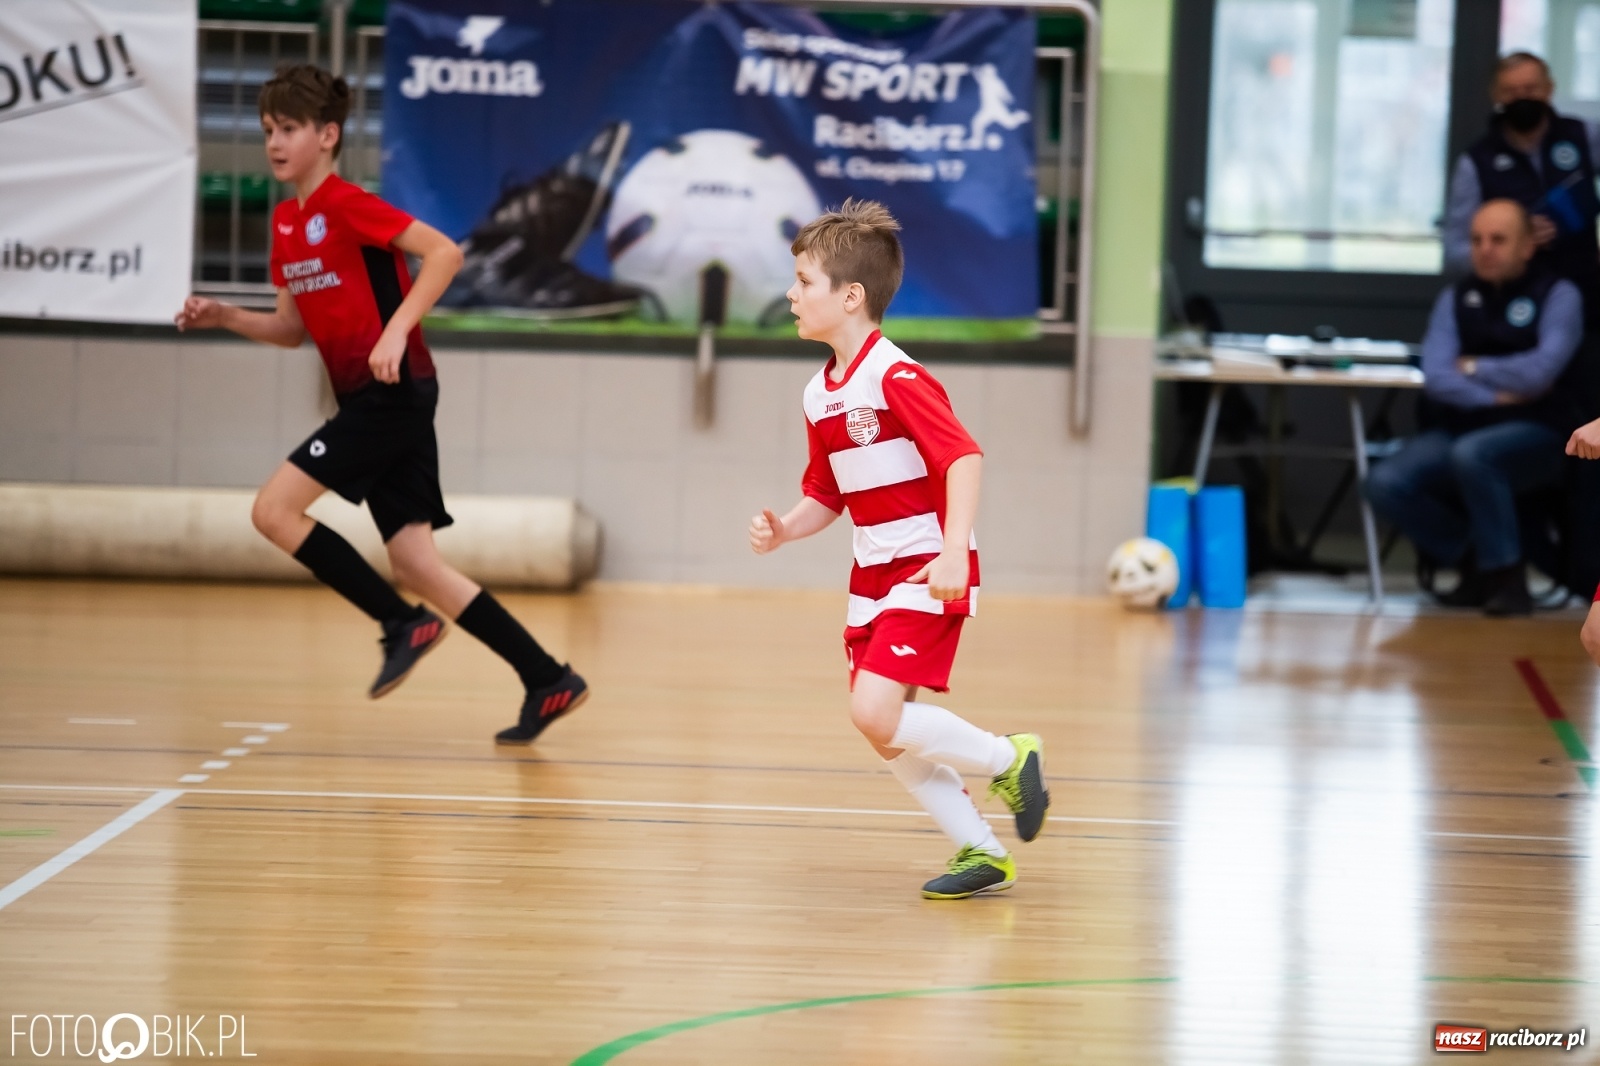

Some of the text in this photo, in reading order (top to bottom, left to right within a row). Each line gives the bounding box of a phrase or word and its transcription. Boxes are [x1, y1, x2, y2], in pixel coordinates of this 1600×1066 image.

[734, 56, 970, 102] MW SPORT
[847, 420, 878, 429] WSP
